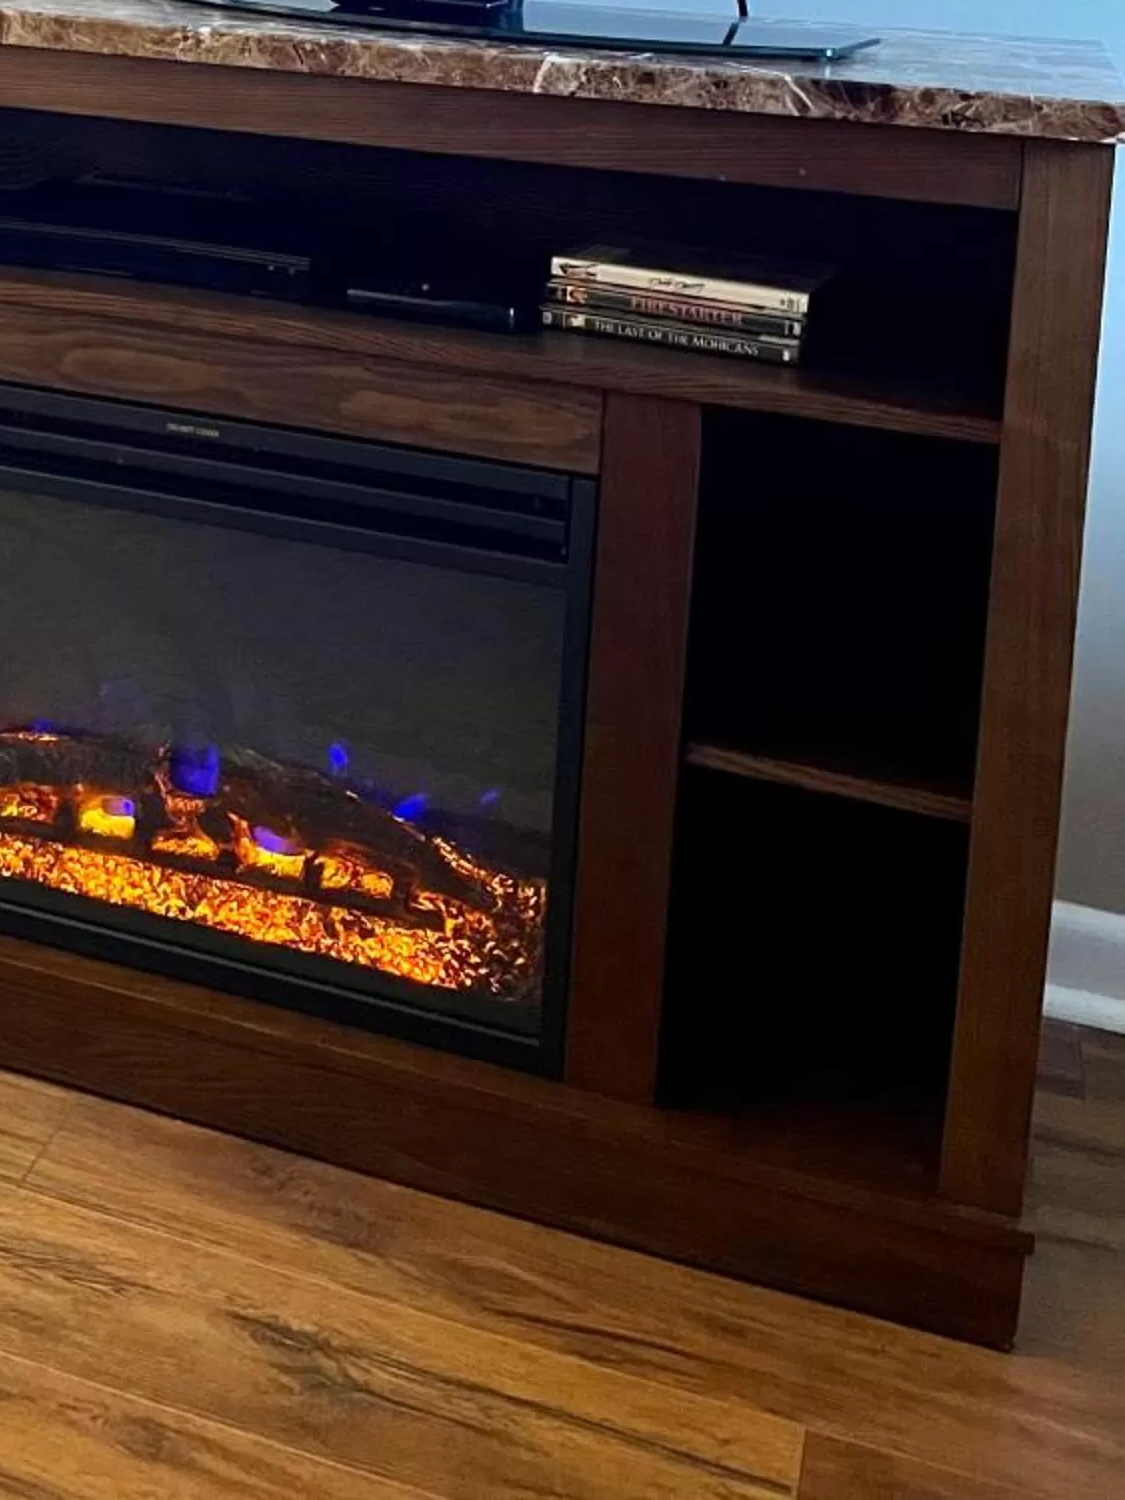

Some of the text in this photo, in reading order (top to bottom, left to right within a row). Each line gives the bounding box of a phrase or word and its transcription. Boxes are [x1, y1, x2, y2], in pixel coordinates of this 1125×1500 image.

[594, 319, 760, 357] THE LAST OF THE MOHICANS
